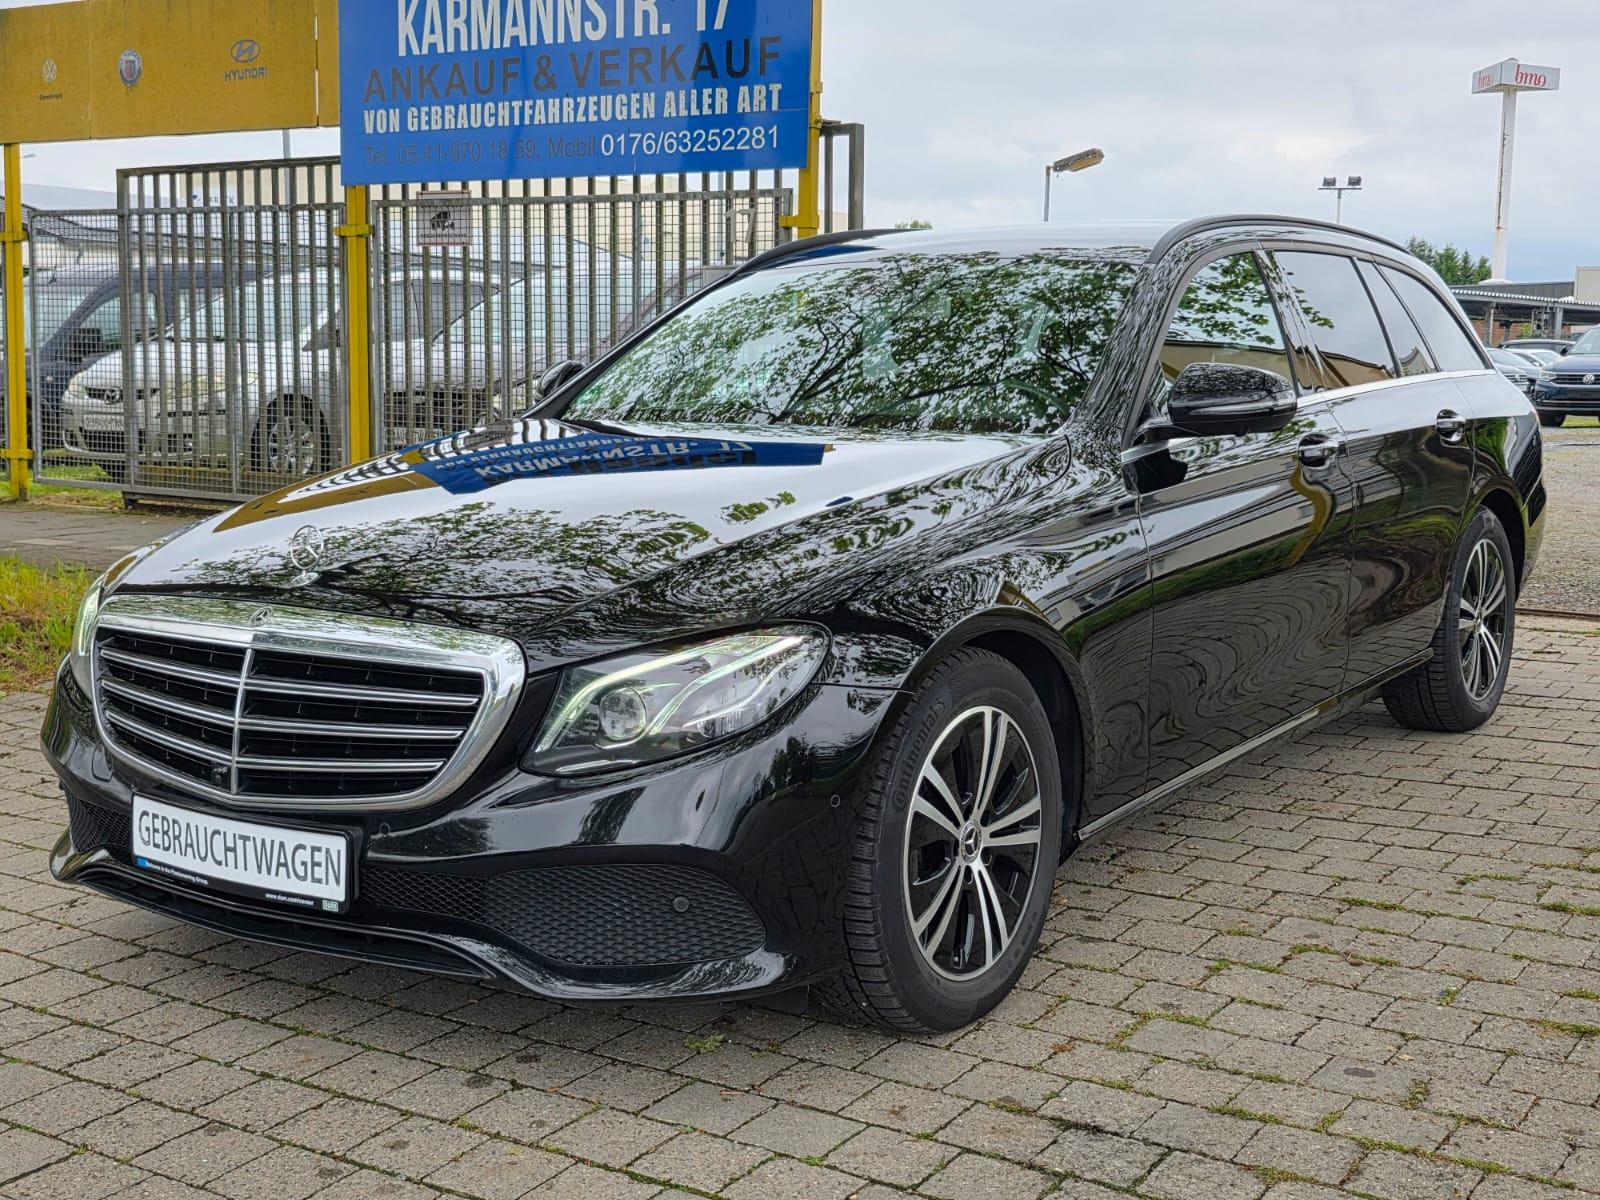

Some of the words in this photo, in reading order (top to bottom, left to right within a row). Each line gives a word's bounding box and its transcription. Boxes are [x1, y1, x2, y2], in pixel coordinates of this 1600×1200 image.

[398, 0, 671, 57] KARMANNSTR.
[224, 66, 268, 82] HYUNDAI
[363, 57, 521, 103] ANKAUF
[533, 54, 557, 92] &
[570, 36, 782, 89] VERKAUF
[363, 108, 400, 134] VON
[407, 92, 656, 132] GEBRAUCHTFAHRZEUGEN
[663, 87, 728, 118] ALLER
[736, 83, 782, 113] ART
[365, 146, 391, 167] Tel.
[549, 135, 596, 158] Mobil
[601, 125, 778, 156] 0176/63252281
[724, 208, 757, 243] 17
[138, 810, 341, 887] GEBRAUCHTWAGEN
